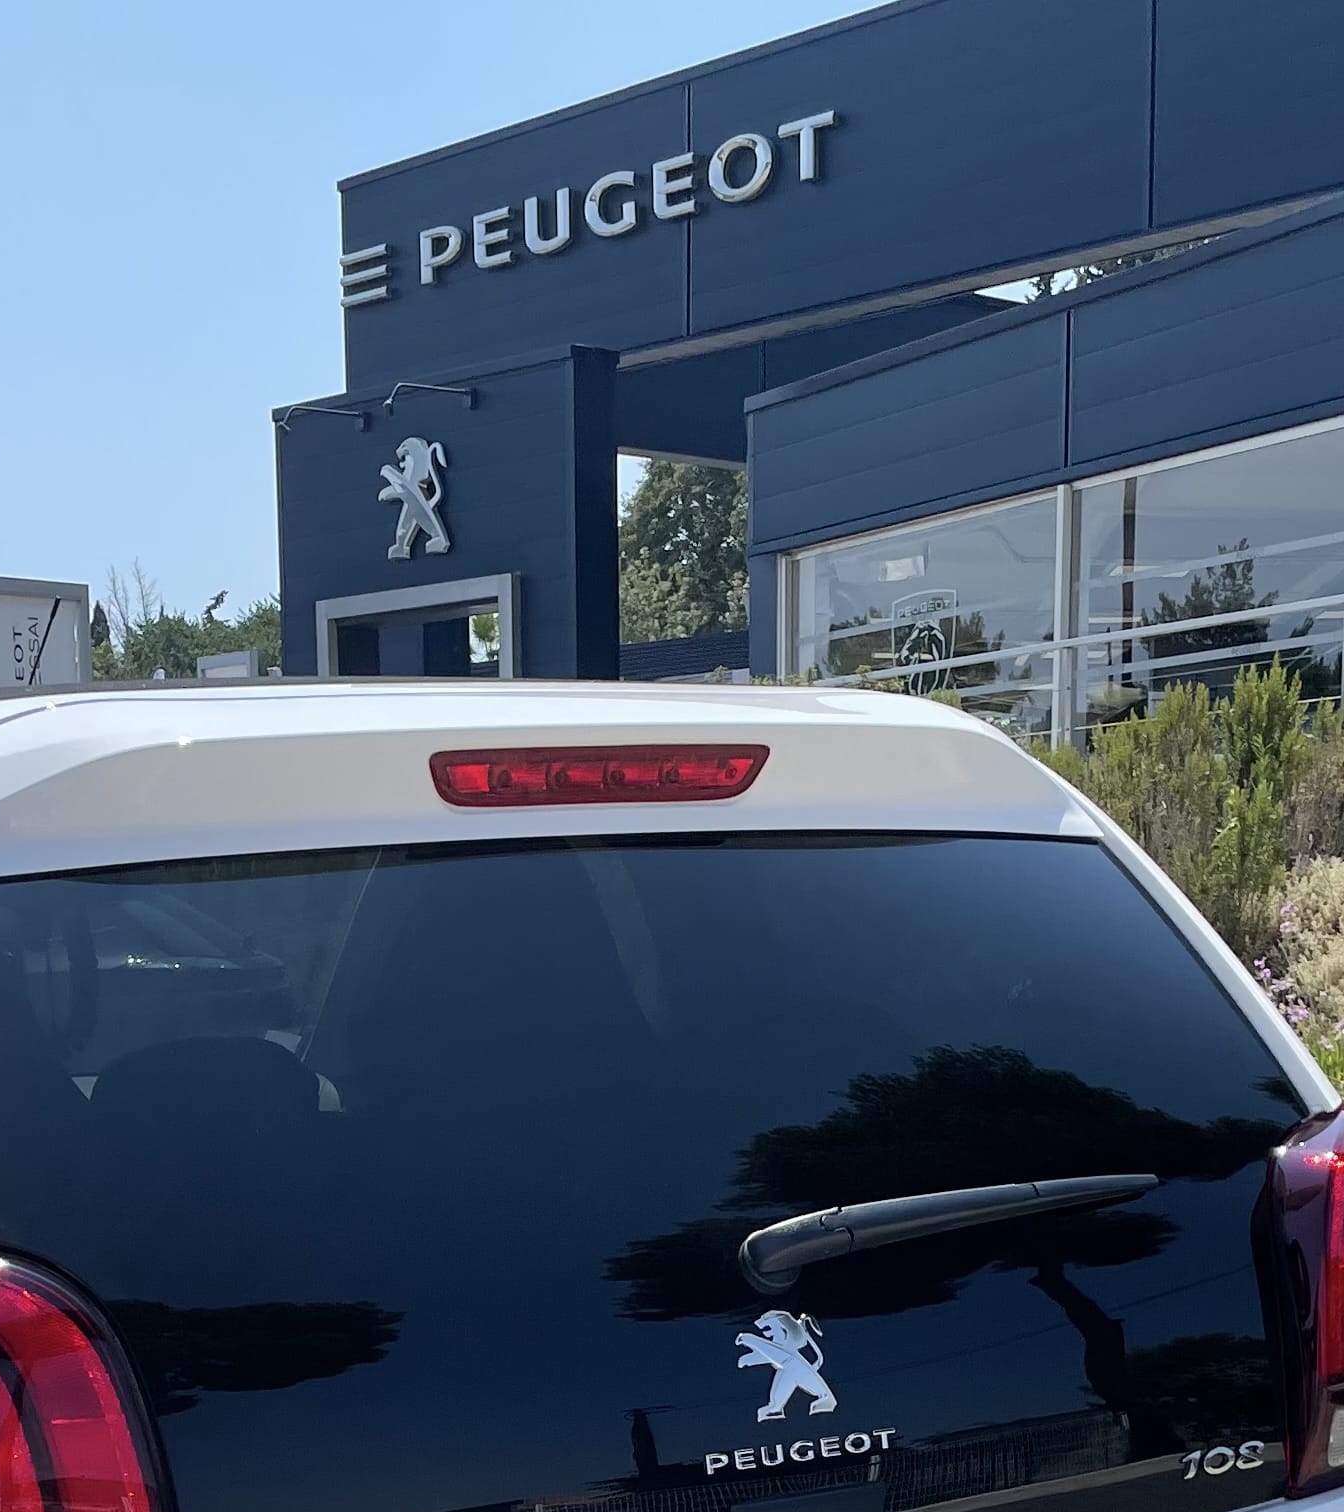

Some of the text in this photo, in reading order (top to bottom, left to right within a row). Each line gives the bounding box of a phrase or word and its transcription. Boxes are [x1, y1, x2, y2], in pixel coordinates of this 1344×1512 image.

[419, 109, 839, 286] PEUGEOT
[705, 1427, 897, 1475] PEUGEOT
[1182, 1440, 1265, 1480] 108
